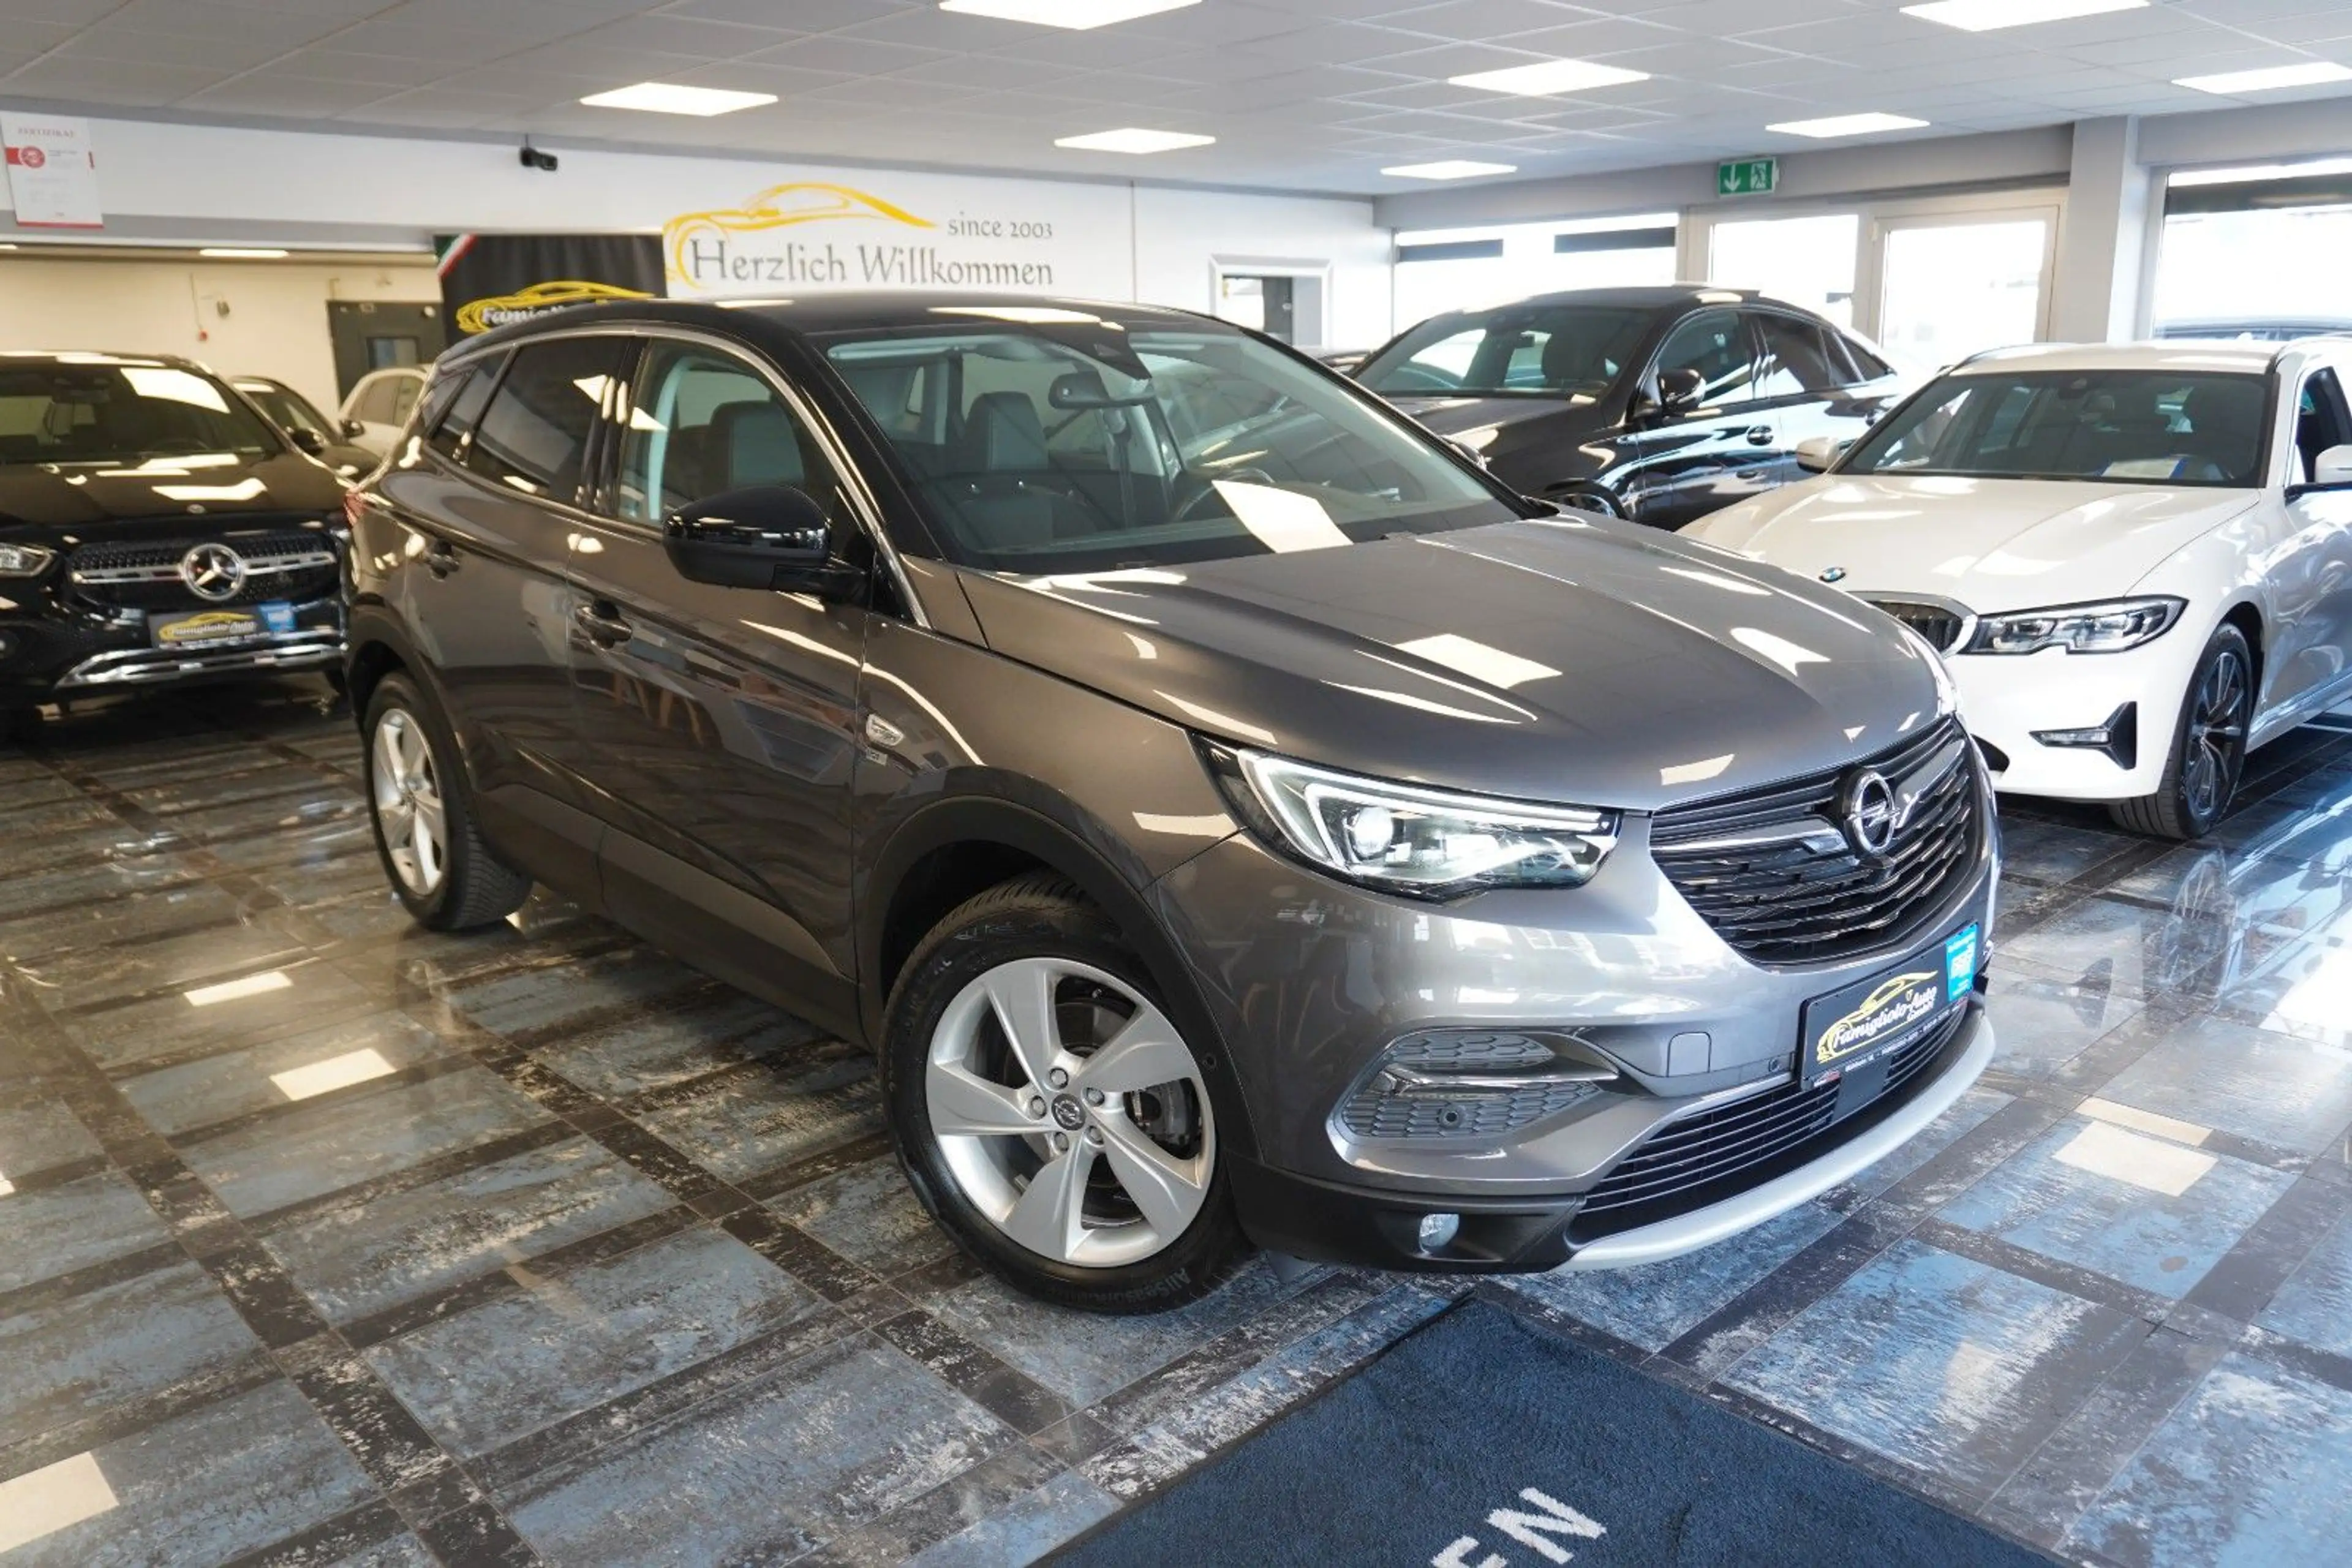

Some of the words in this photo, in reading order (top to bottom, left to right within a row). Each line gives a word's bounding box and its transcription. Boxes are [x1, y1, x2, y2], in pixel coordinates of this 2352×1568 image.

[947, 211, 1002, 238] since
[1009, 221, 1053, 238] 2003
[689, 238, 848, 282] Herzlich
[858, 244, 1054, 285] Willkommen
